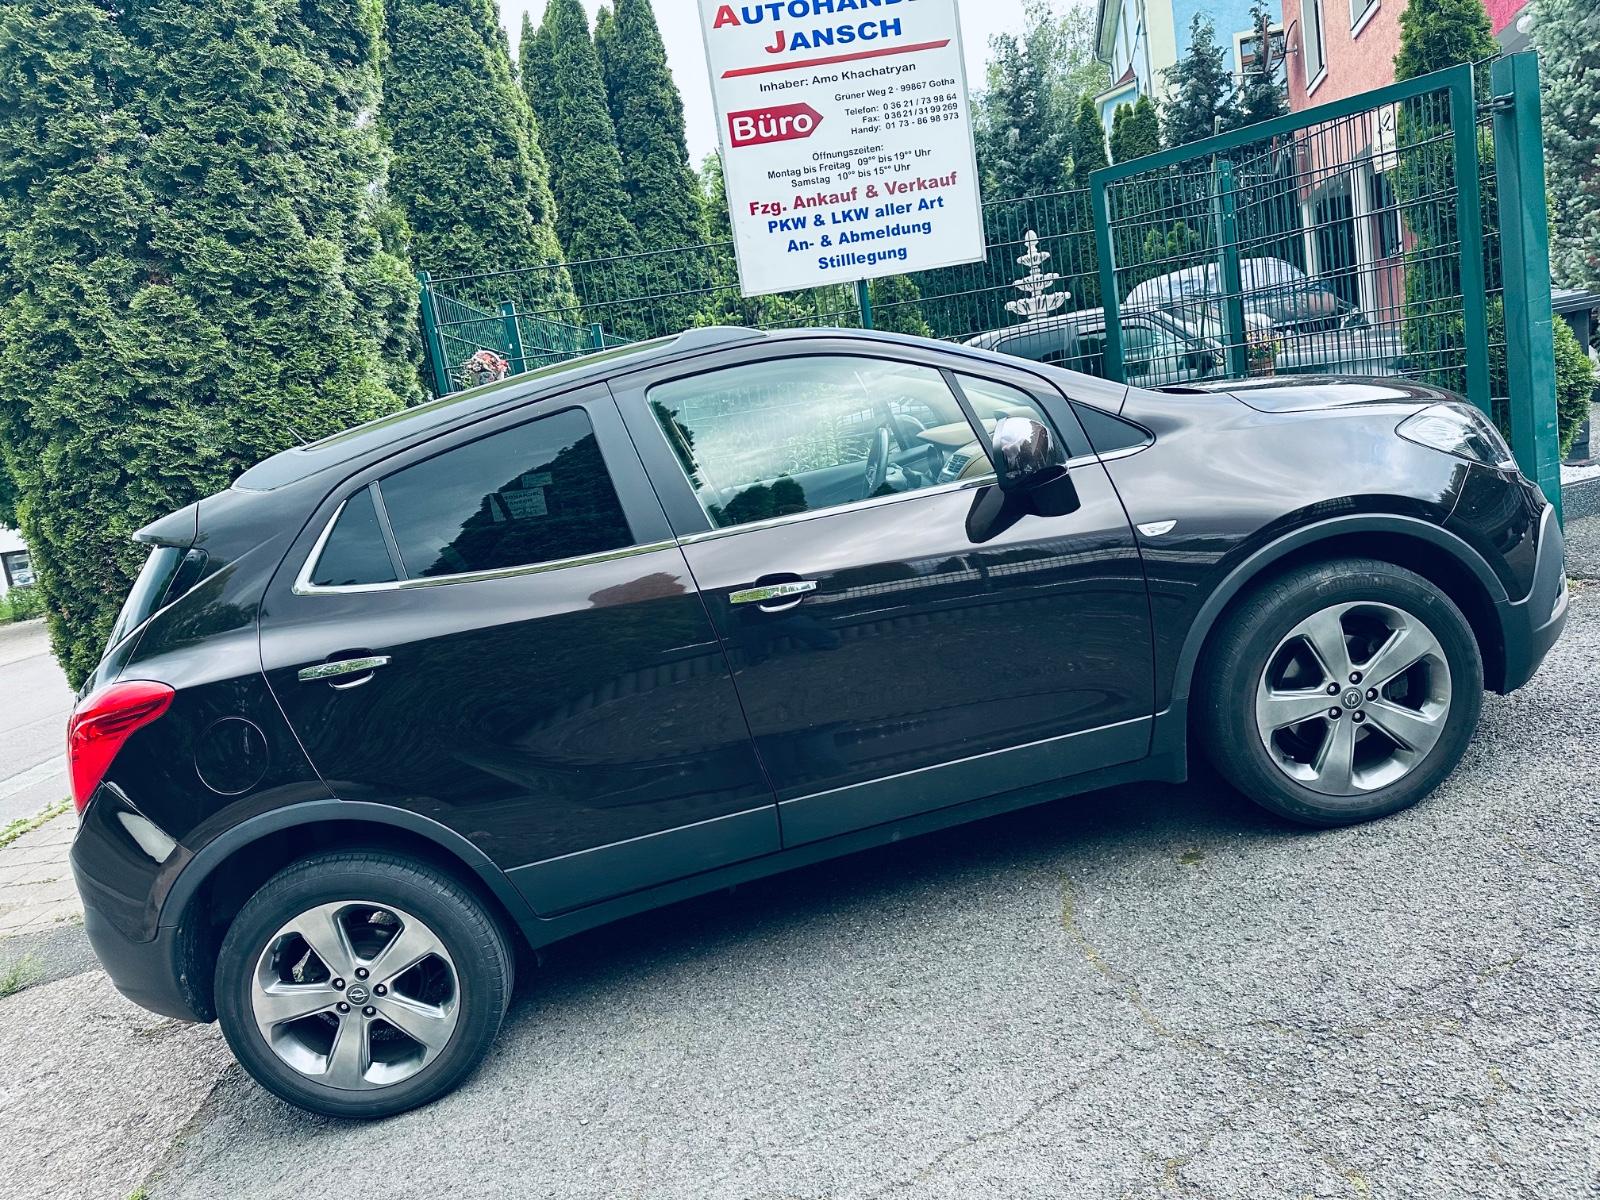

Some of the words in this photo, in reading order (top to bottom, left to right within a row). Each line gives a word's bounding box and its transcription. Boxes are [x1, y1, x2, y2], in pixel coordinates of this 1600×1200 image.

[765, 17, 902, 54] JANSCH
[759, 77, 809, 92] Inhaber:
[812, 74, 838, 85] Amo
[841, 63, 916, 81] Khachatryan
[867, 89, 886, 97] Weg
[888, 86, 894, 94] 2
[900, 81, 927, 92] 99867
[929, 79, 955, 88] Gotha
[845, 105, 879, 116] Telefon:
[862, 115, 880, 123] Fax:
[732, 113, 814, 141] Büro
[851, 124, 882, 135] Handy:
[767, 167, 801, 179] Montag
[803, 164, 817, 174] bis
[819, 160, 850, 172] Freitag
[878, 153, 893, 163] bis
[914, 148, 932, 158] Uhr
[791, 175, 830, 188] Samstag
[857, 168, 872, 178] bis
[893, 163, 911, 173] Uhr
[749, 201, 787, 216] Fzg.
[793, 187, 858, 210] Ankauf
[865, 184, 878, 198] &
[884, 172, 957, 195] Verkauf
[768, 216, 807, 233] PKW
[813, 214, 825, 227] &
[831, 207, 869, 225] LKW
[875, 201, 913, 218] aller
[918, 195, 944, 211] Art
[787, 239, 814, 252] An-
[820, 235, 832, 247] &
[839, 222, 932, 245] Abmeldung
[818, 247, 908, 270] Stilllegung
